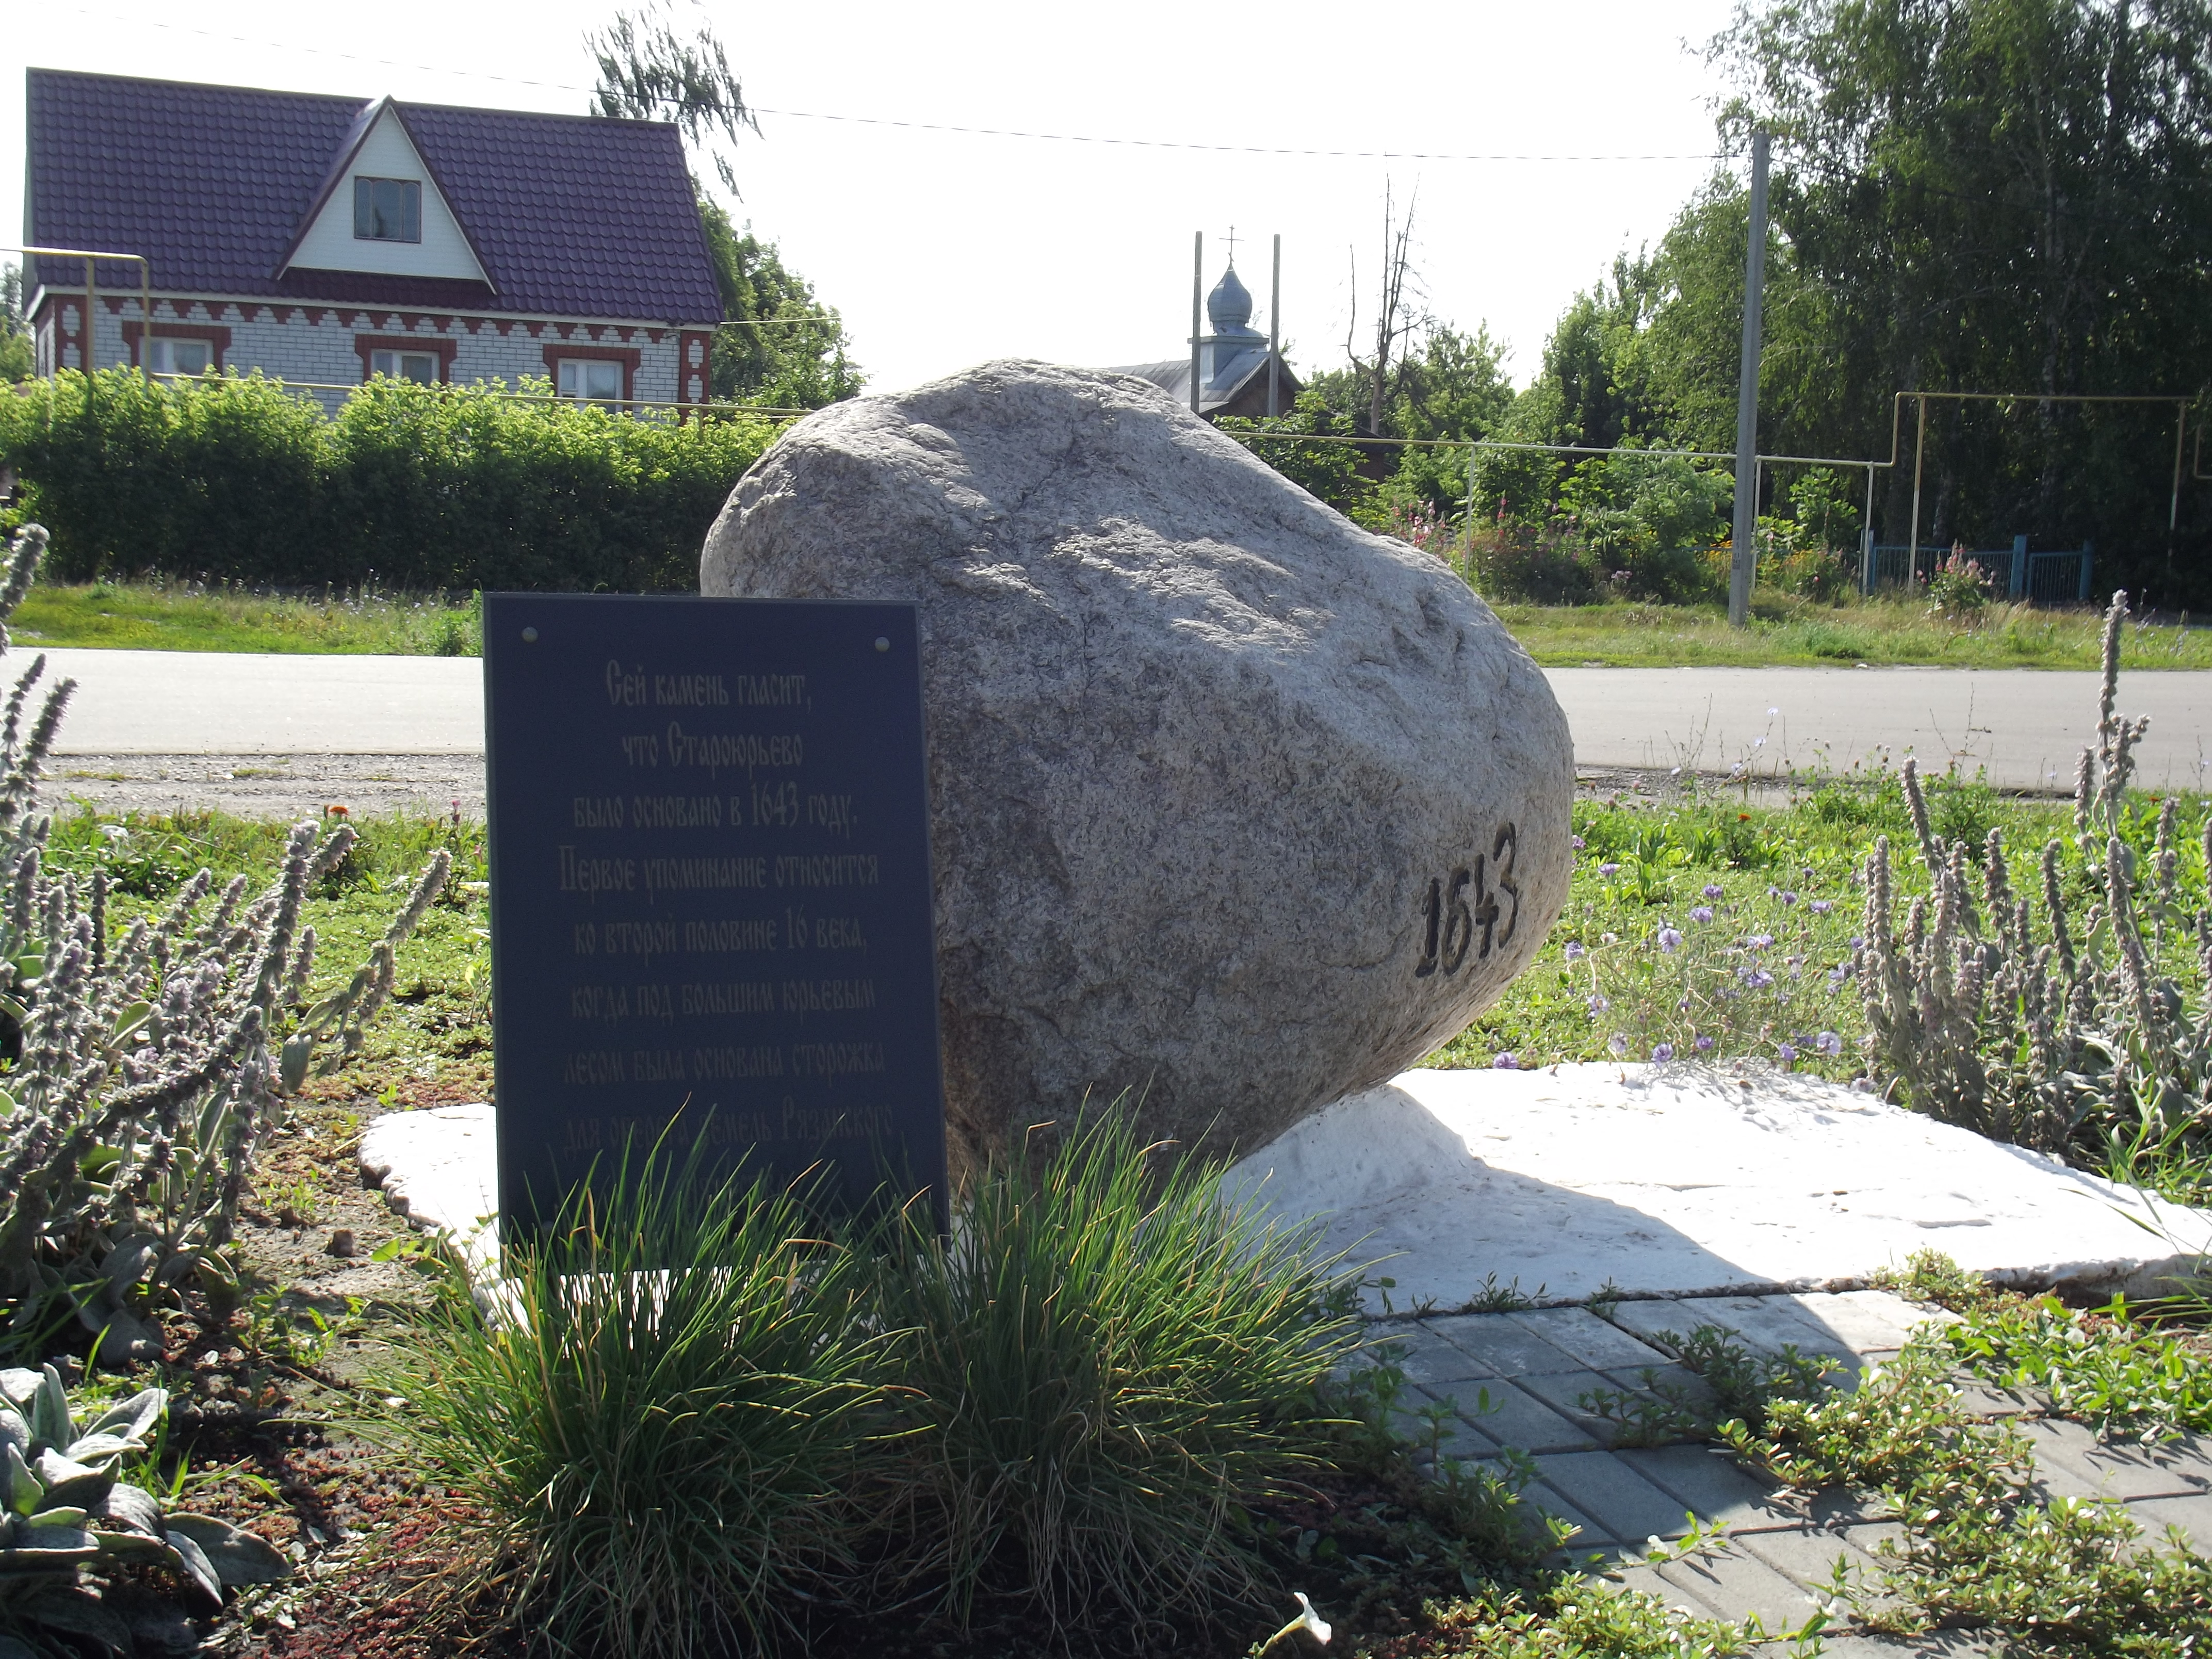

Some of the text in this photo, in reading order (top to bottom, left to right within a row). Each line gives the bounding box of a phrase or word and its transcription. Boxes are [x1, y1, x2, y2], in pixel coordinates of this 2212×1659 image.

[606, 659, 812, 714] Сей камень гласит,
[622, 721, 803, 780] что Староюрьево
[573, 780, 858, 840] было основано в 1643 году.
[558, 844, 880, 905] Первое упоминание относится
[1415, 821, 1518, 977] 1643
[574, 903, 868, 968] ко второй половине 16 века,
[572, 978, 876, 1029] когда под большим юрьевым
[564, 1042, 886, 1088] лесом была основана сторожка
[564, 1117, 600, 1161] для
[782, 1094, 893, 1142] Рязанского
